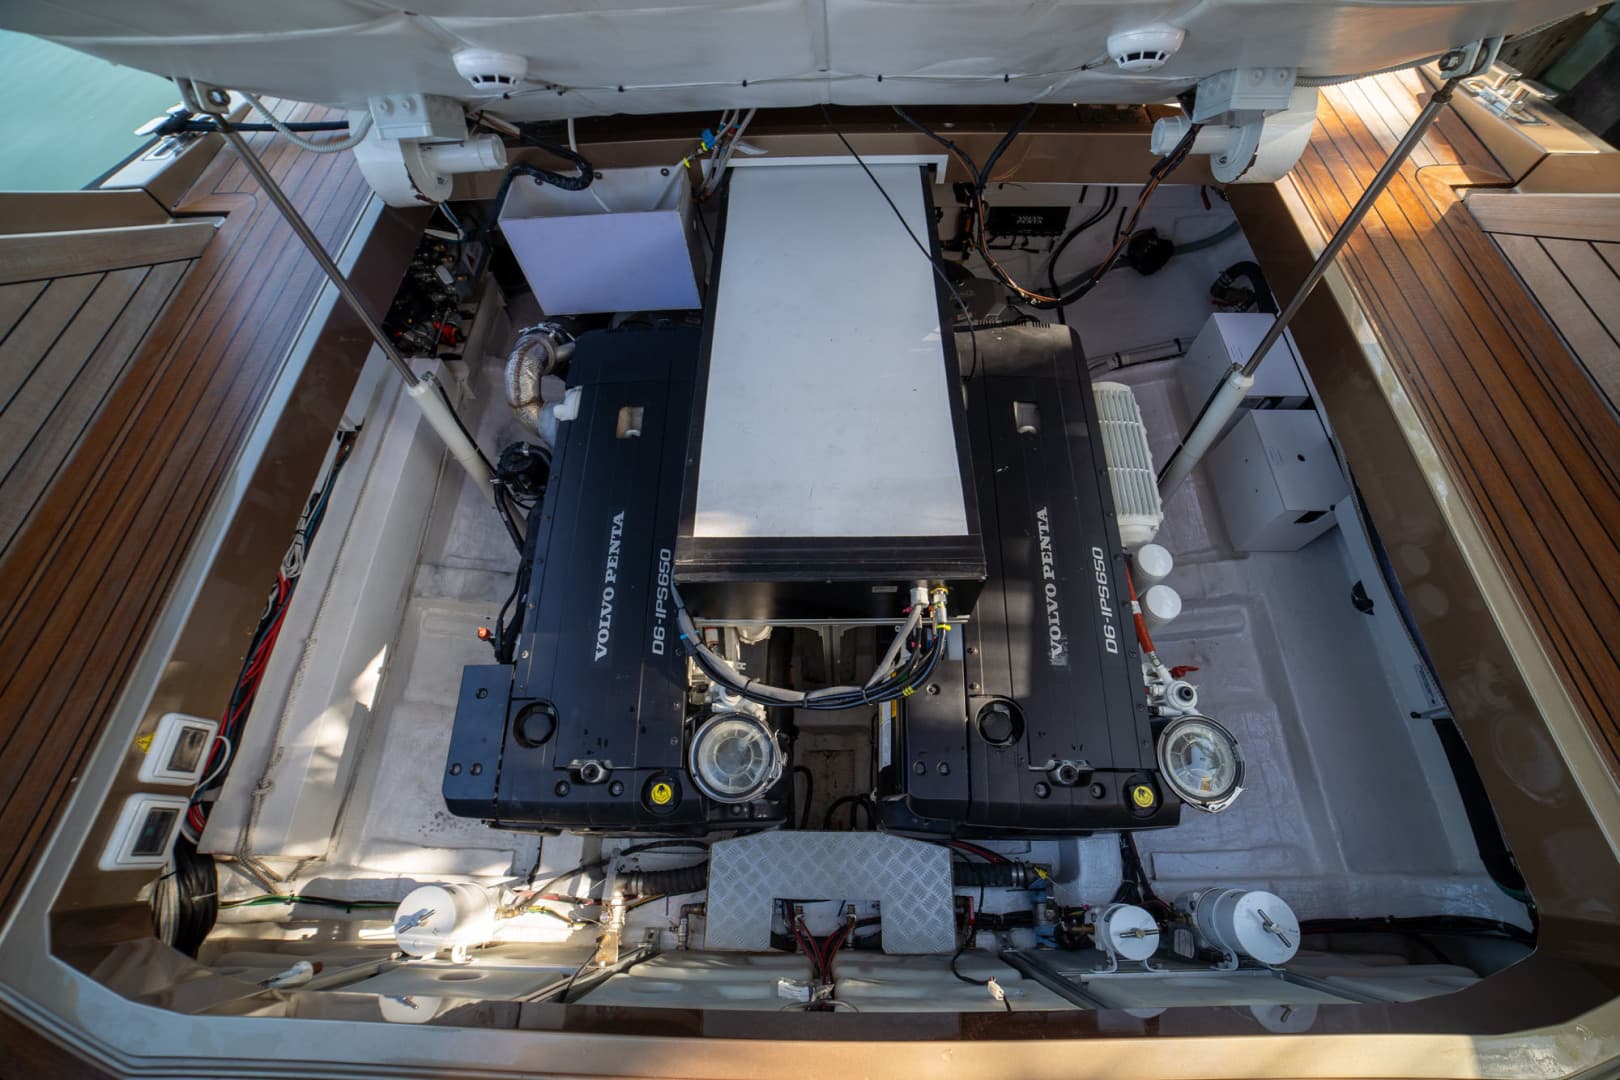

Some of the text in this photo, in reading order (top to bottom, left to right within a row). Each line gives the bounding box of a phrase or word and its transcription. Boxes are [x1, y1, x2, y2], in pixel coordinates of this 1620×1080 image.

[594, 511, 625, 662] VOLVO PENTA
[652, 548, 672, 655] D6-IPS650
[1036, 506, 1063, 660] VOLVO PENTA
[1092, 547, 1118, 655] D6-IPS650
